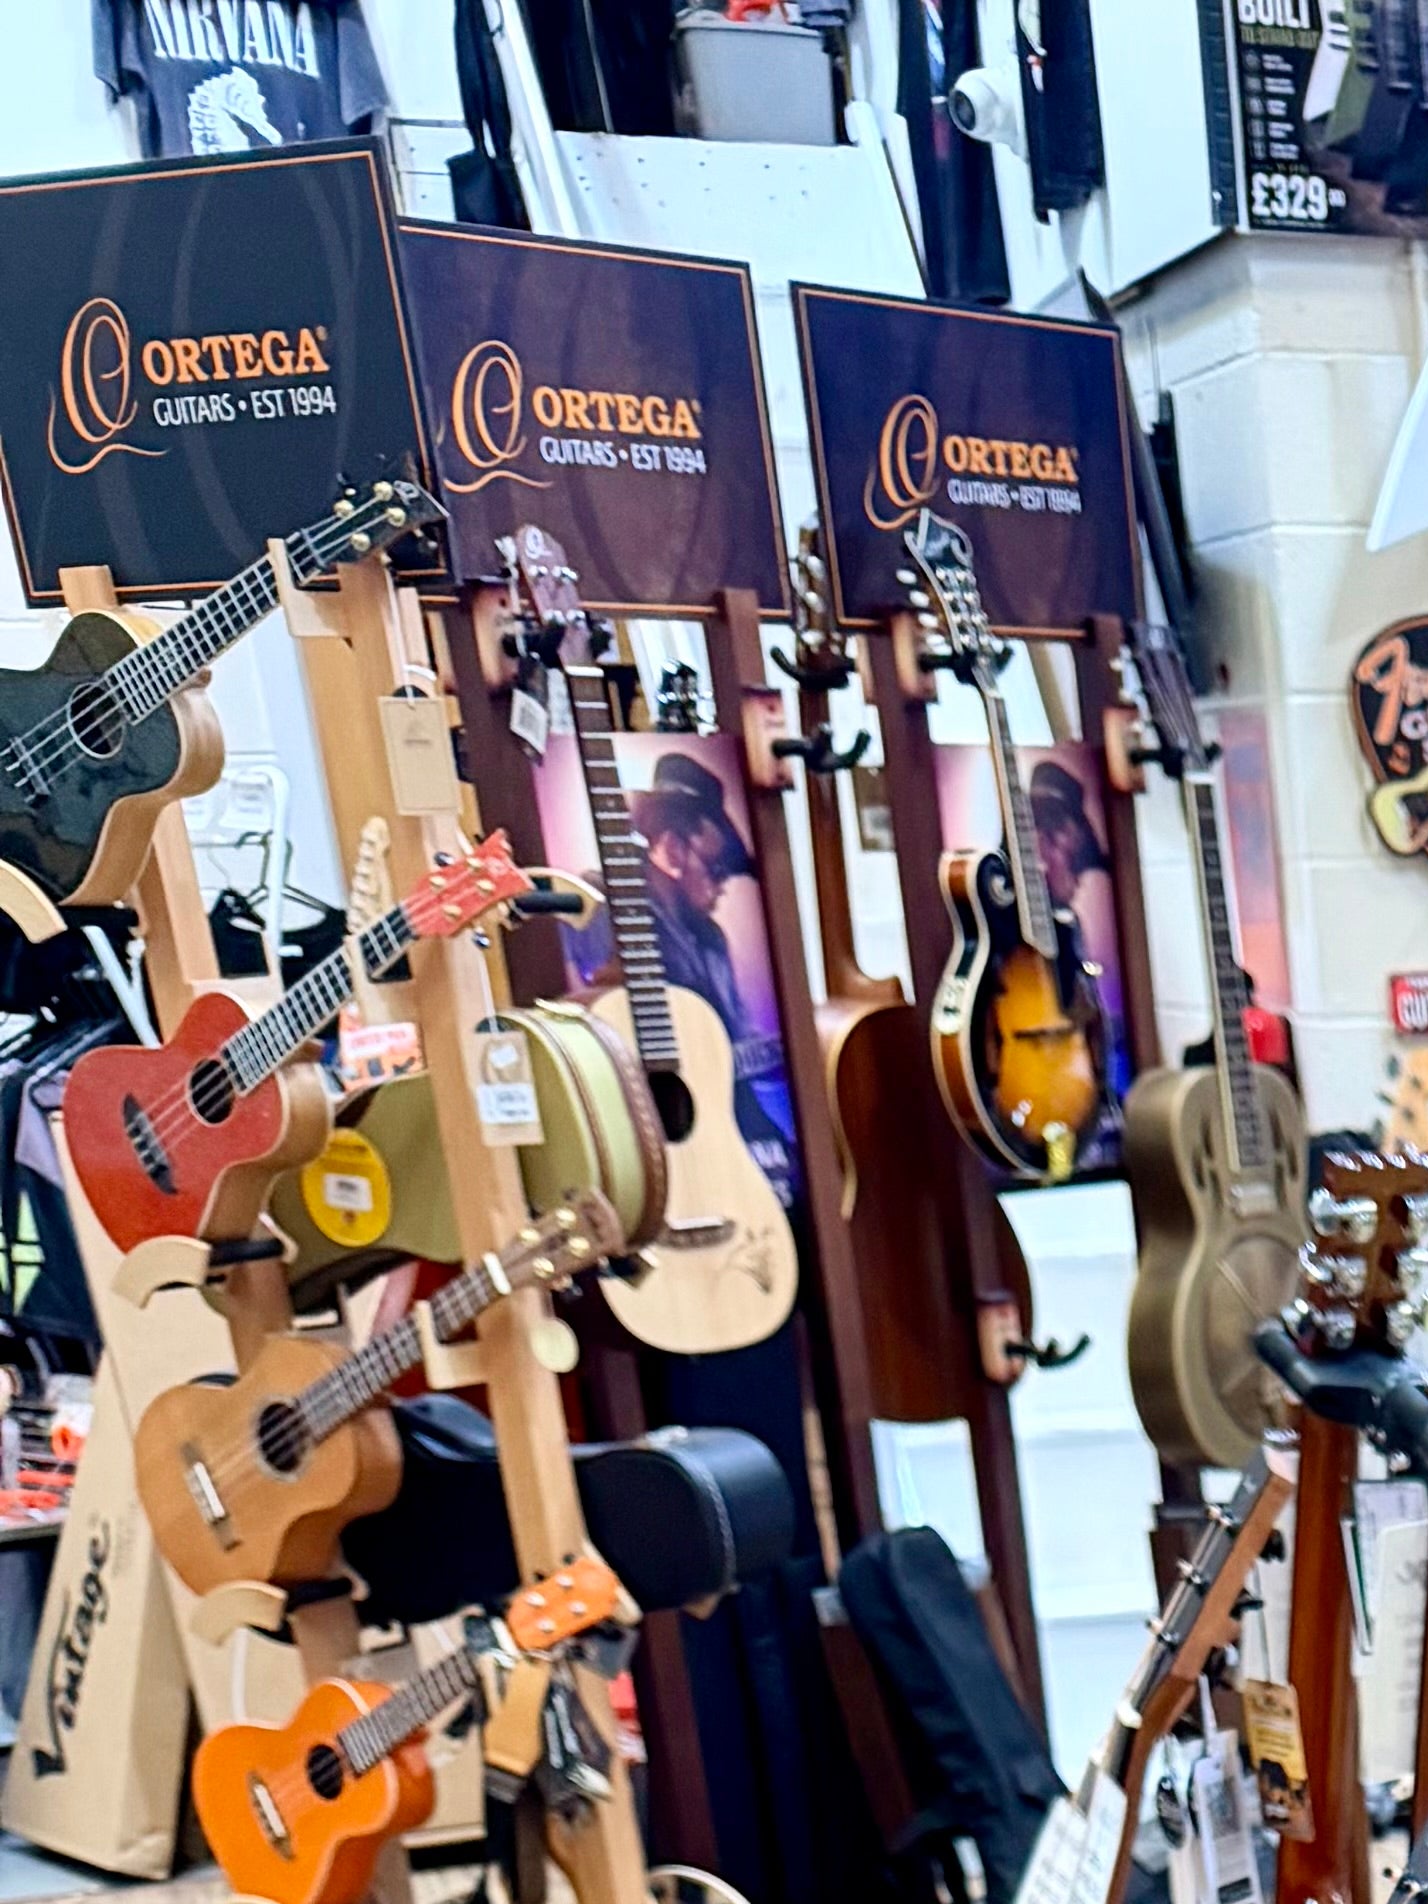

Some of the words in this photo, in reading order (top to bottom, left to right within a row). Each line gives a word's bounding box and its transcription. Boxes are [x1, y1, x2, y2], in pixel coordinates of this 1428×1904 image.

[144, 0, 320, 79] NIRVANA
[1252, 172, 1328, 220] £329
[142, 328, 330, 385] ORTEGA
[153, 393, 235, 426] GUITARS
[251, 389, 285, 419] EST
[287, 386, 337, 416] 1994
[536, 386, 702, 439] ORTEGA
[629, 443, 662, 470] EST
[943, 435, 1079, 483] ORTEGA
[31, 1519, 111, 1779] Vintage
